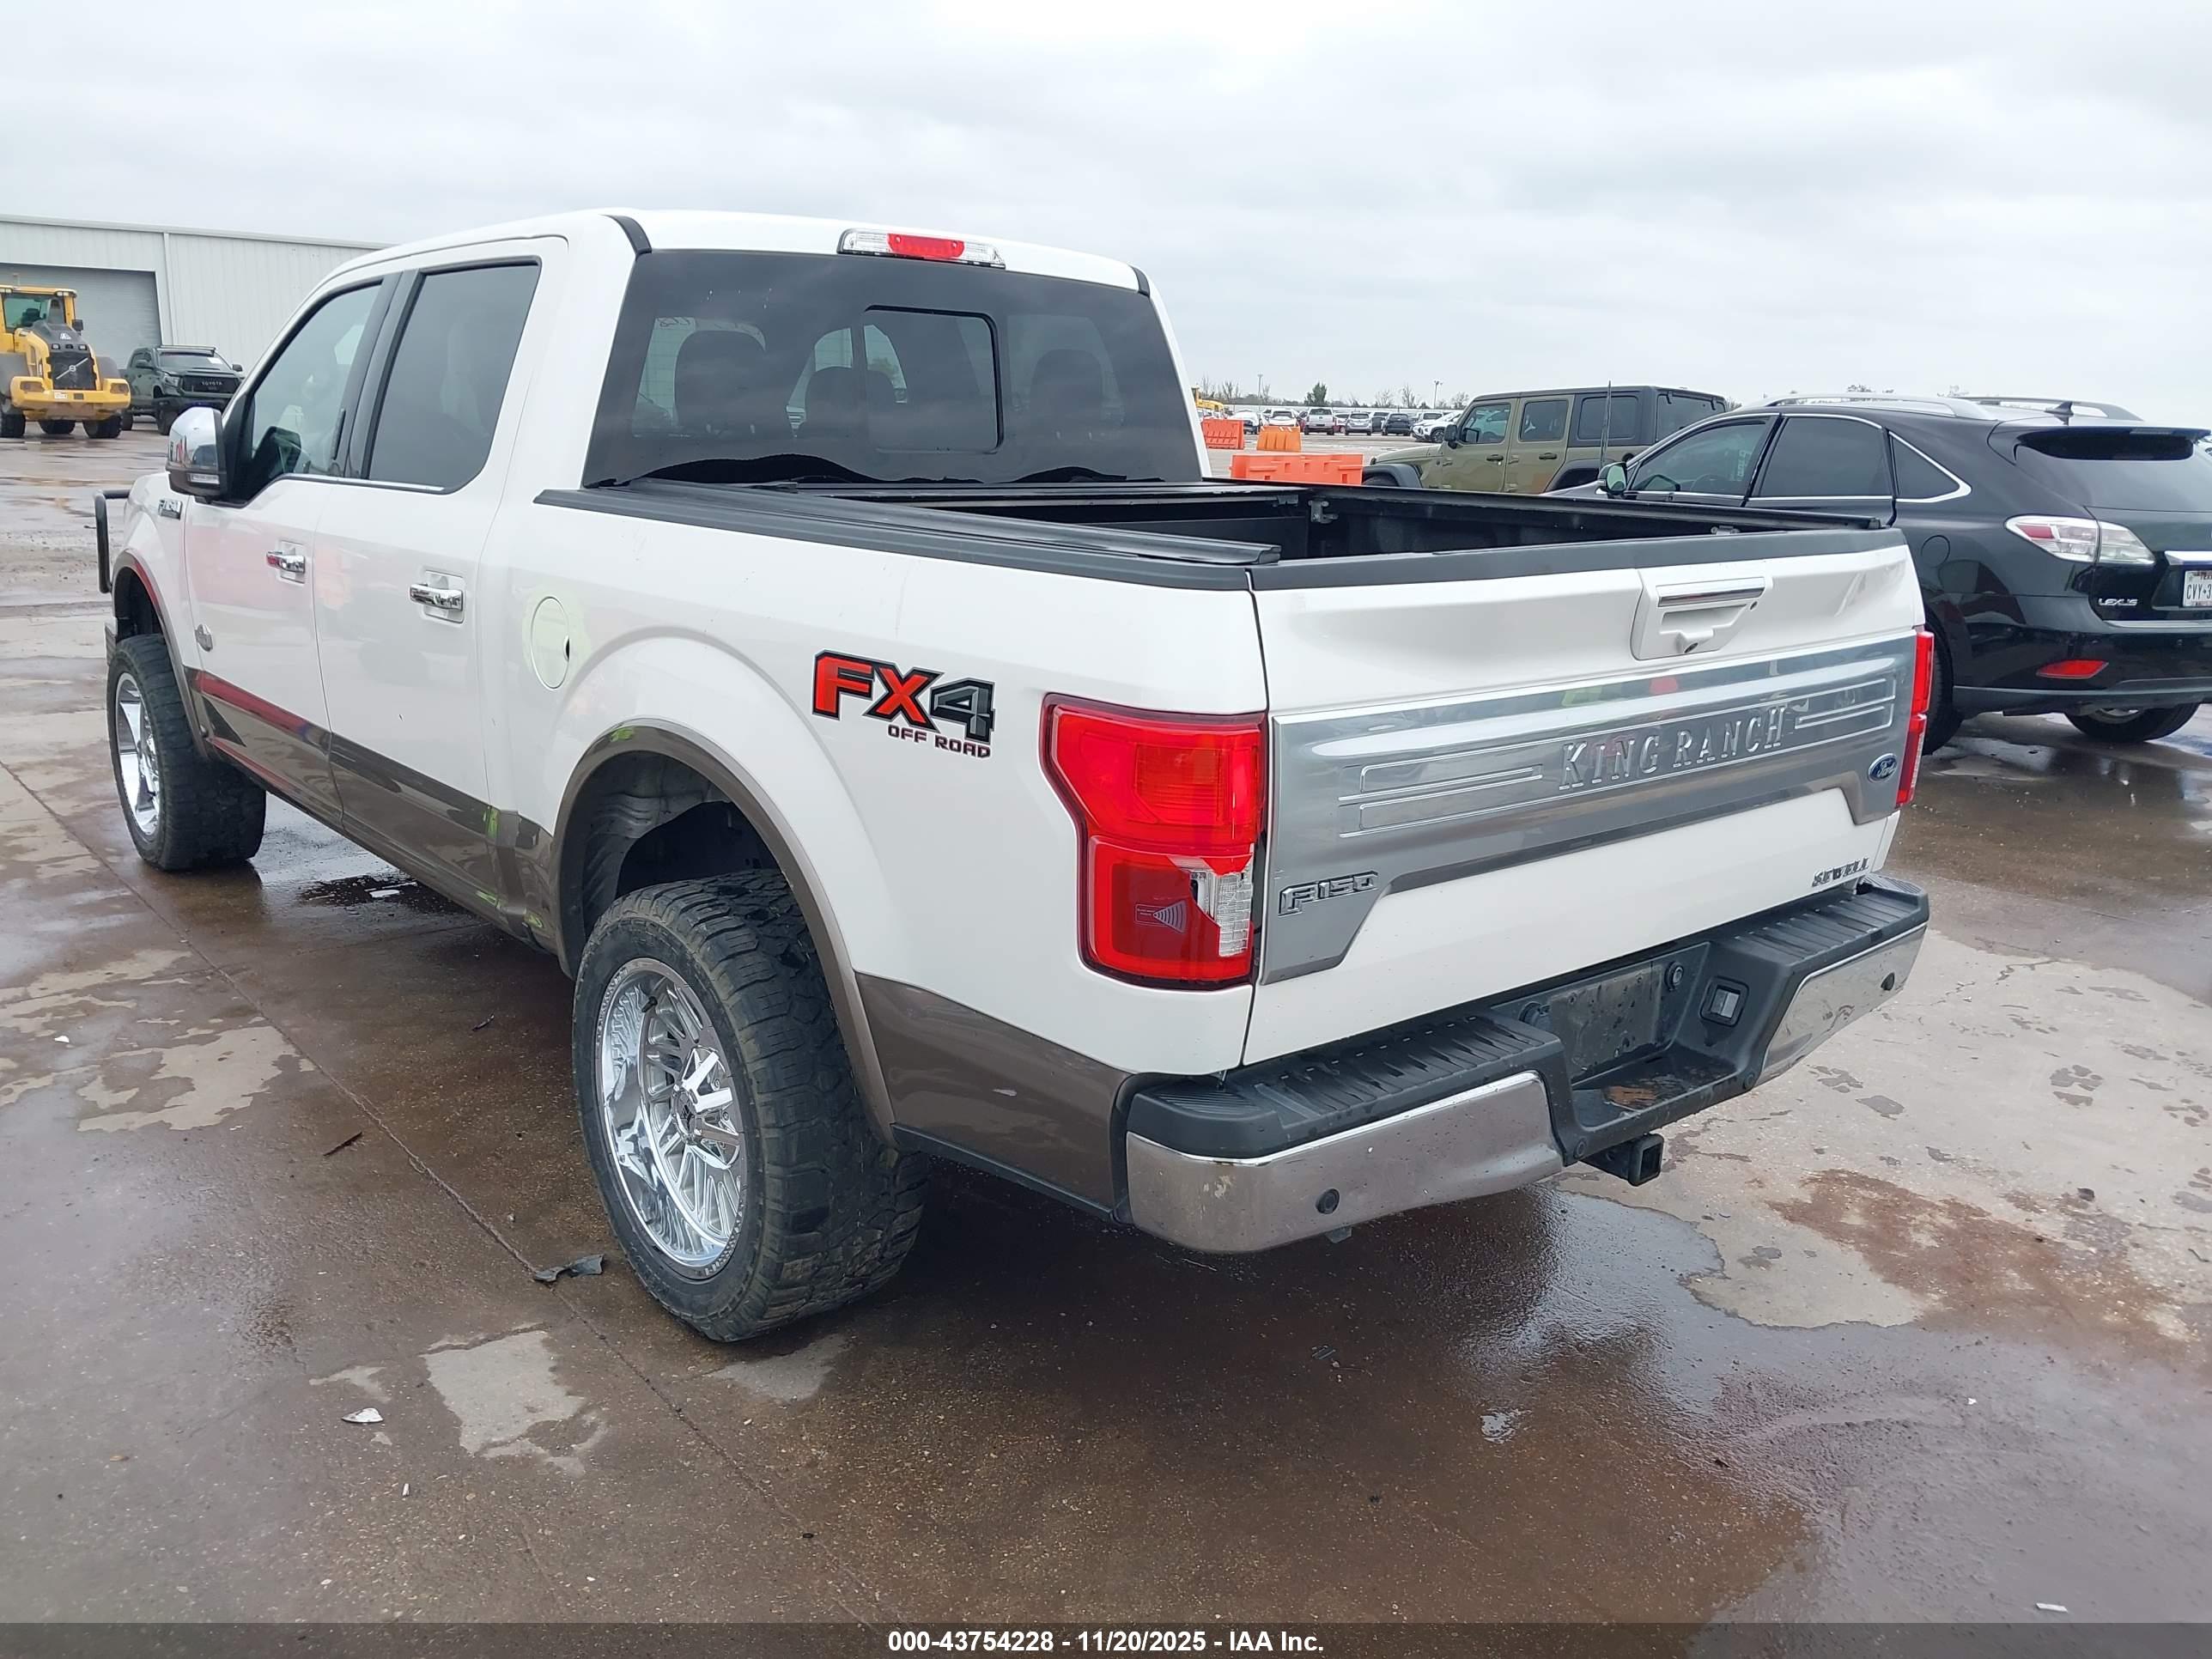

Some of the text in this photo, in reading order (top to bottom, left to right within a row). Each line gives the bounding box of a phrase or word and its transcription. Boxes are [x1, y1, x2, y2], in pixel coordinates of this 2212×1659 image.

[2098, 598, 2138, 606] LEXUS
[812, 648, 995, 745] FX4
[888, 724, 991, 758] OFF ROAD
[1559, 706, 1786, 789] KING RANCH
